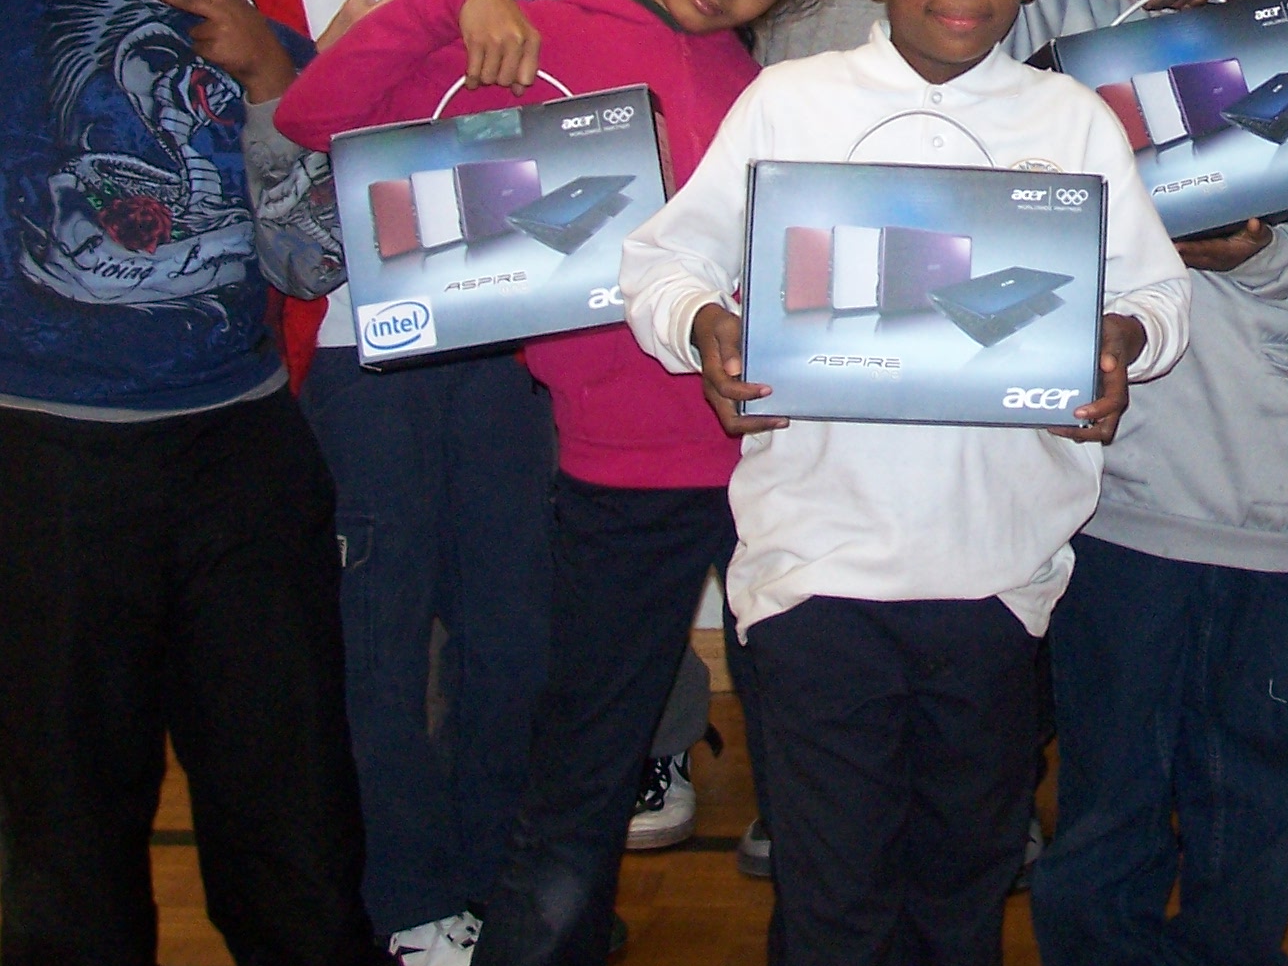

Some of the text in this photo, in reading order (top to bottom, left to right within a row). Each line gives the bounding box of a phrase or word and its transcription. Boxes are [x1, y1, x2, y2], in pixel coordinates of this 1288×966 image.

[561, 115, 595, 130] acer
[1152, 172, 1223, 195] ASPIRE
[1011, 189, 1047, 201] acer
[444, 271, 527, 292] ASPIRE
[588, 286, 623, 308] ac
[371, 311, 420, 337] intel
[808, 356, 900, 368] ASPIRE
[1002, 386, 1080, 410] acer
